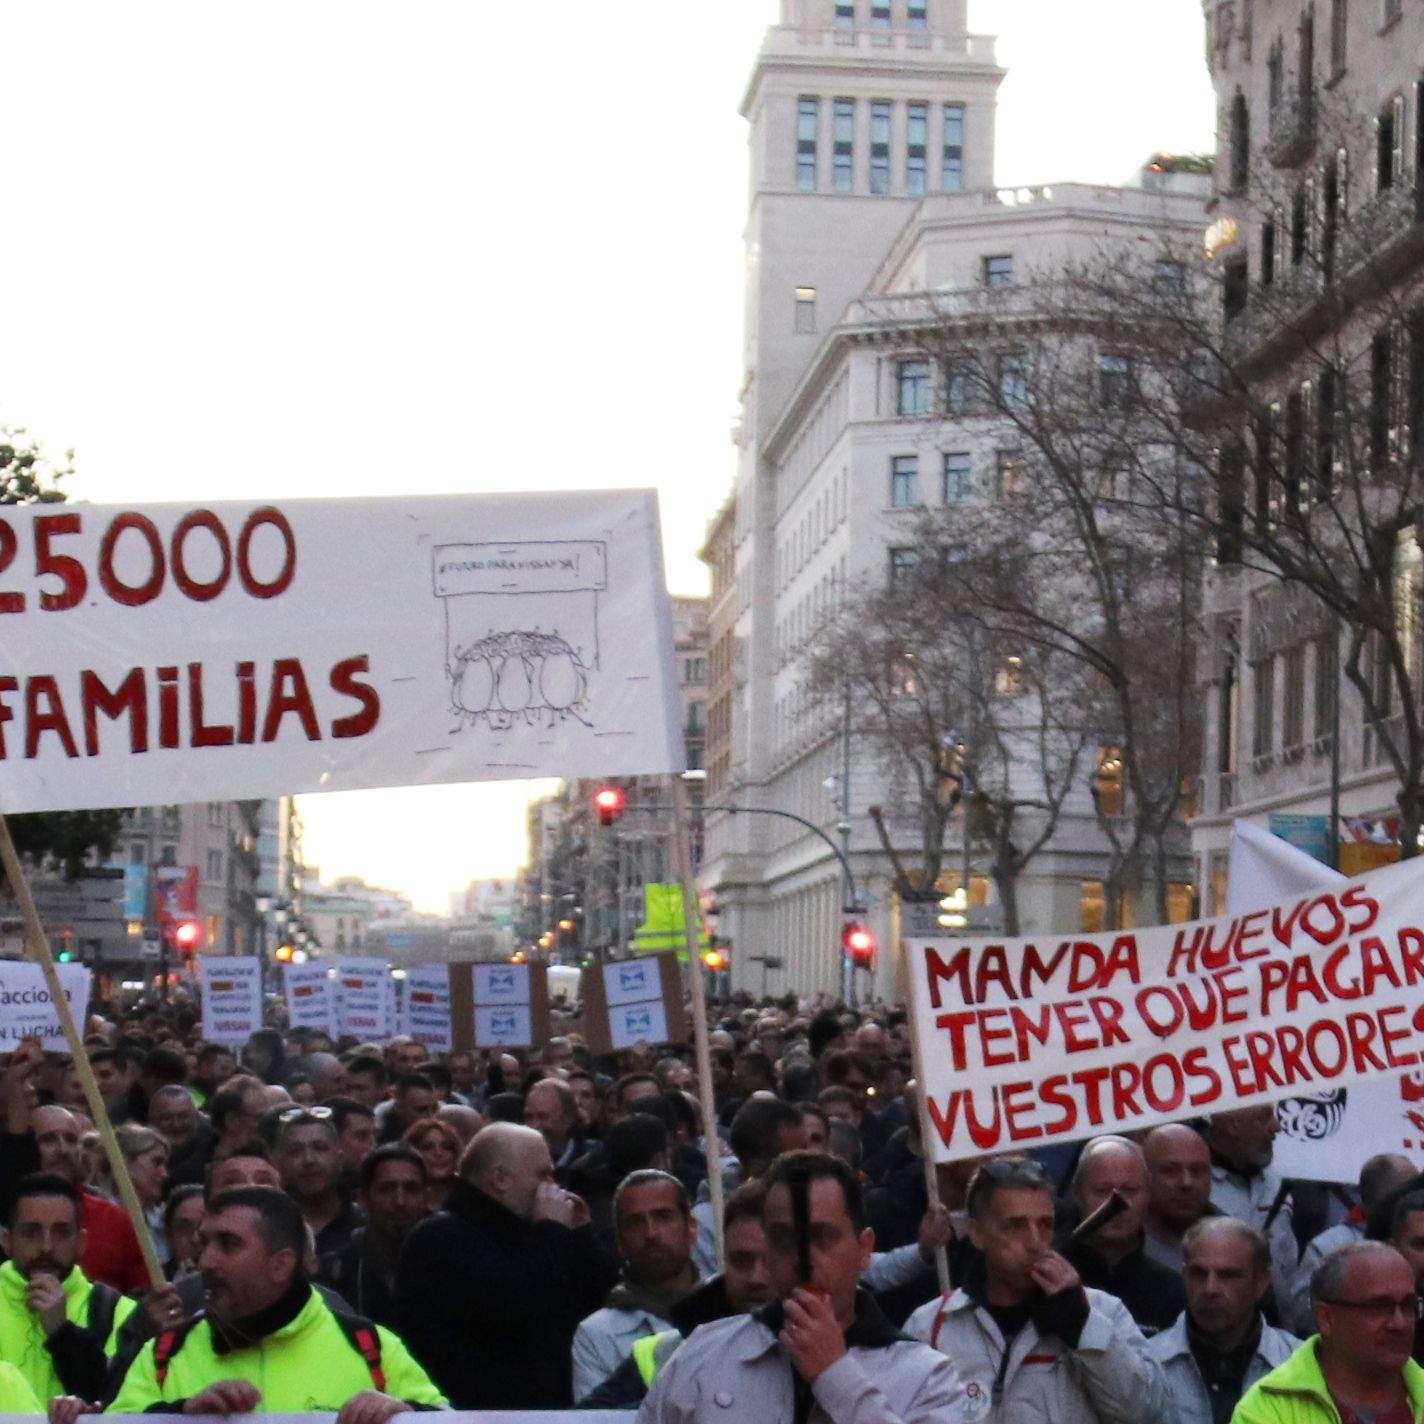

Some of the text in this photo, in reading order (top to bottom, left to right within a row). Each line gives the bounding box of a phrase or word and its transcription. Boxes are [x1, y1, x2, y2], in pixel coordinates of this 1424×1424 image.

[924, 884, 1379, 1009] MANDA HUEVOS
[936, 995, 1129, 1072] TENER
[1136, 965, 1249, 1039] QUE
[926, 1047, 1223, 1151] VUESTROS
